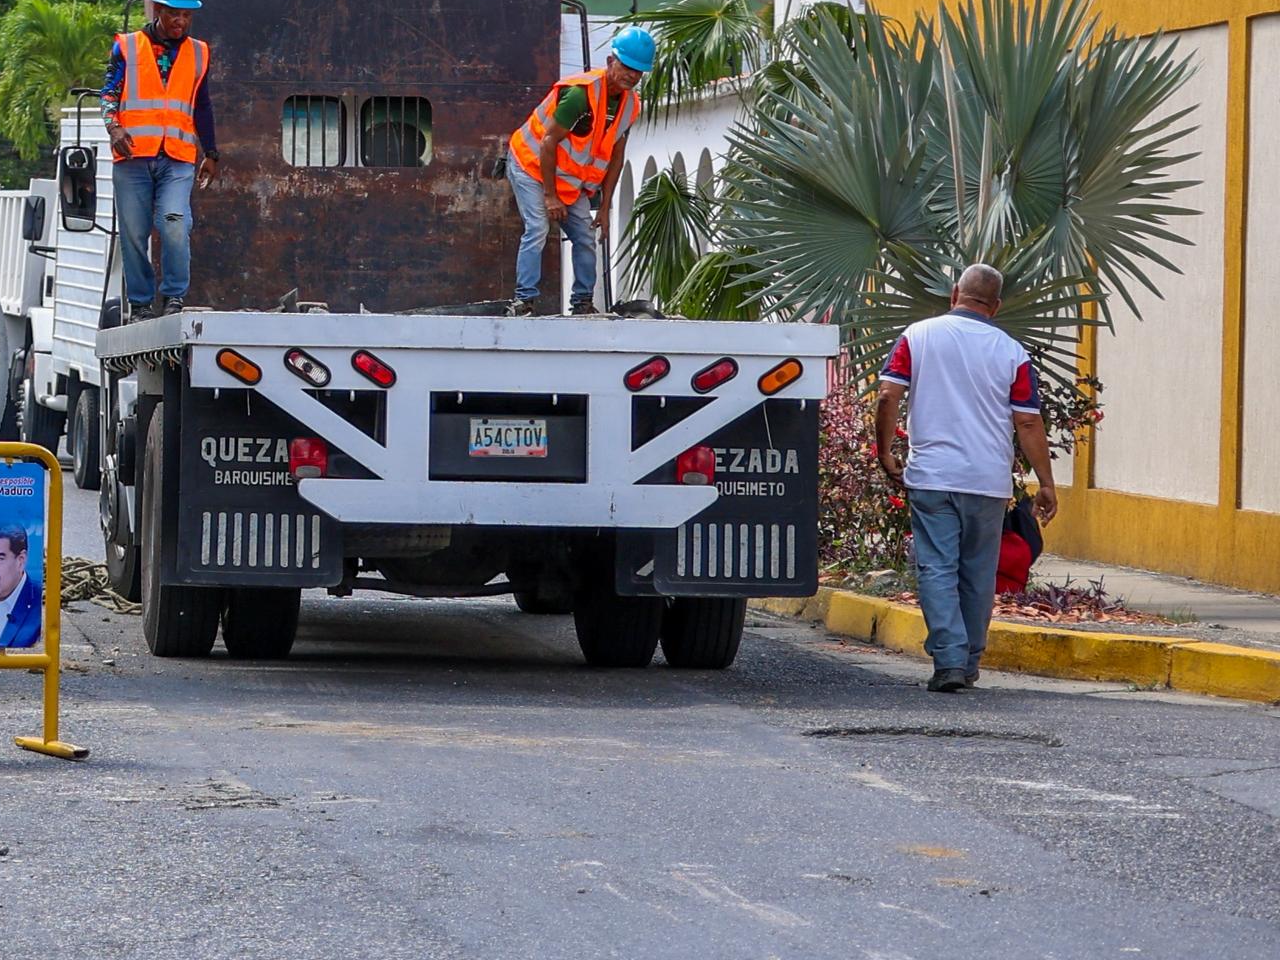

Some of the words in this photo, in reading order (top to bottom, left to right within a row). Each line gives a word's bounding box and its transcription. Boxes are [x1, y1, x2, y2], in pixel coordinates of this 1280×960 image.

[201, 437, 289, 467] QUEZA
[713, 448, 800, 474] EZADA
[215, 470, 294, 486] BARQUISIME
[715, 481, 785, 497] QUISIMETO
